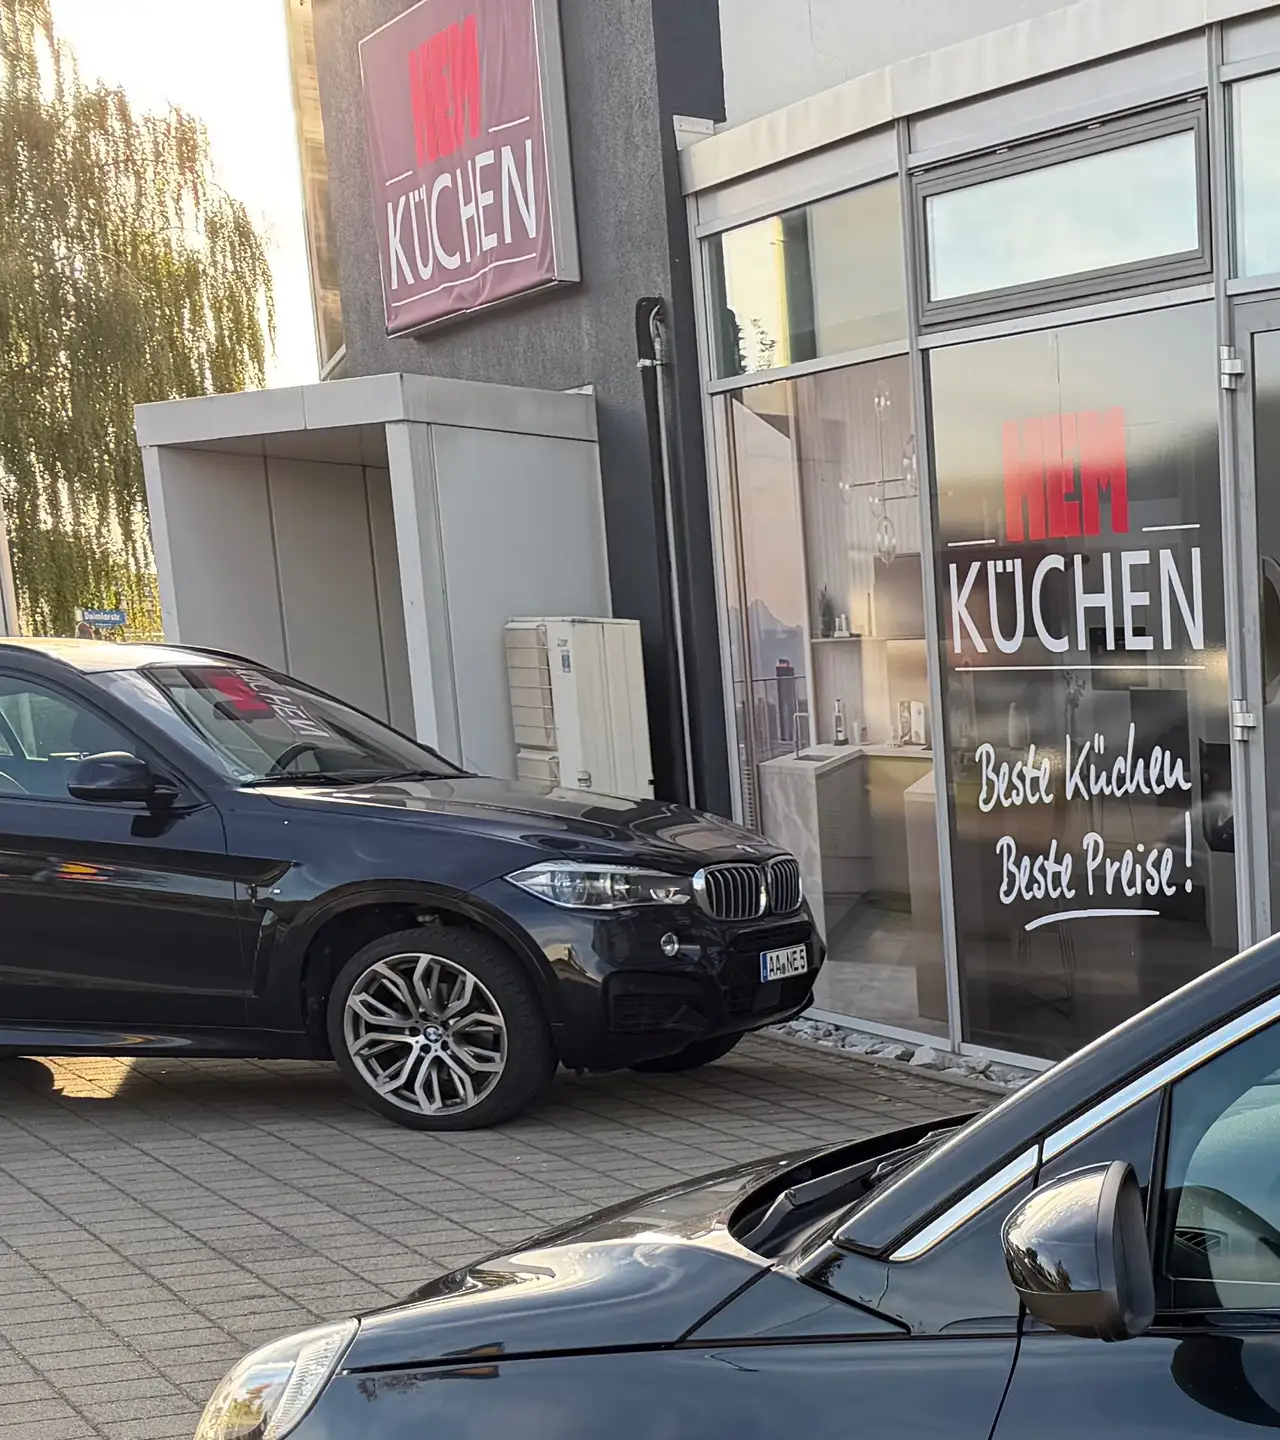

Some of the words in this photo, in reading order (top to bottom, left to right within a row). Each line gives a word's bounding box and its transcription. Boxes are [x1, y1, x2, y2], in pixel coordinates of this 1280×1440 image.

[386, 138, 538, 291] KÜCHEN
[1001, 406, 1130, 543] HEM
[948, 546, 1205, 655] KÜCHEN
[975, 743, 1054, 813] Beste
[1065, 722, 1193, 801] Küchen
[996, 835, 1076, 905] Beste
[1082, 810, 1193, 897] Preise!
[769, 953, 782, 978] AA
